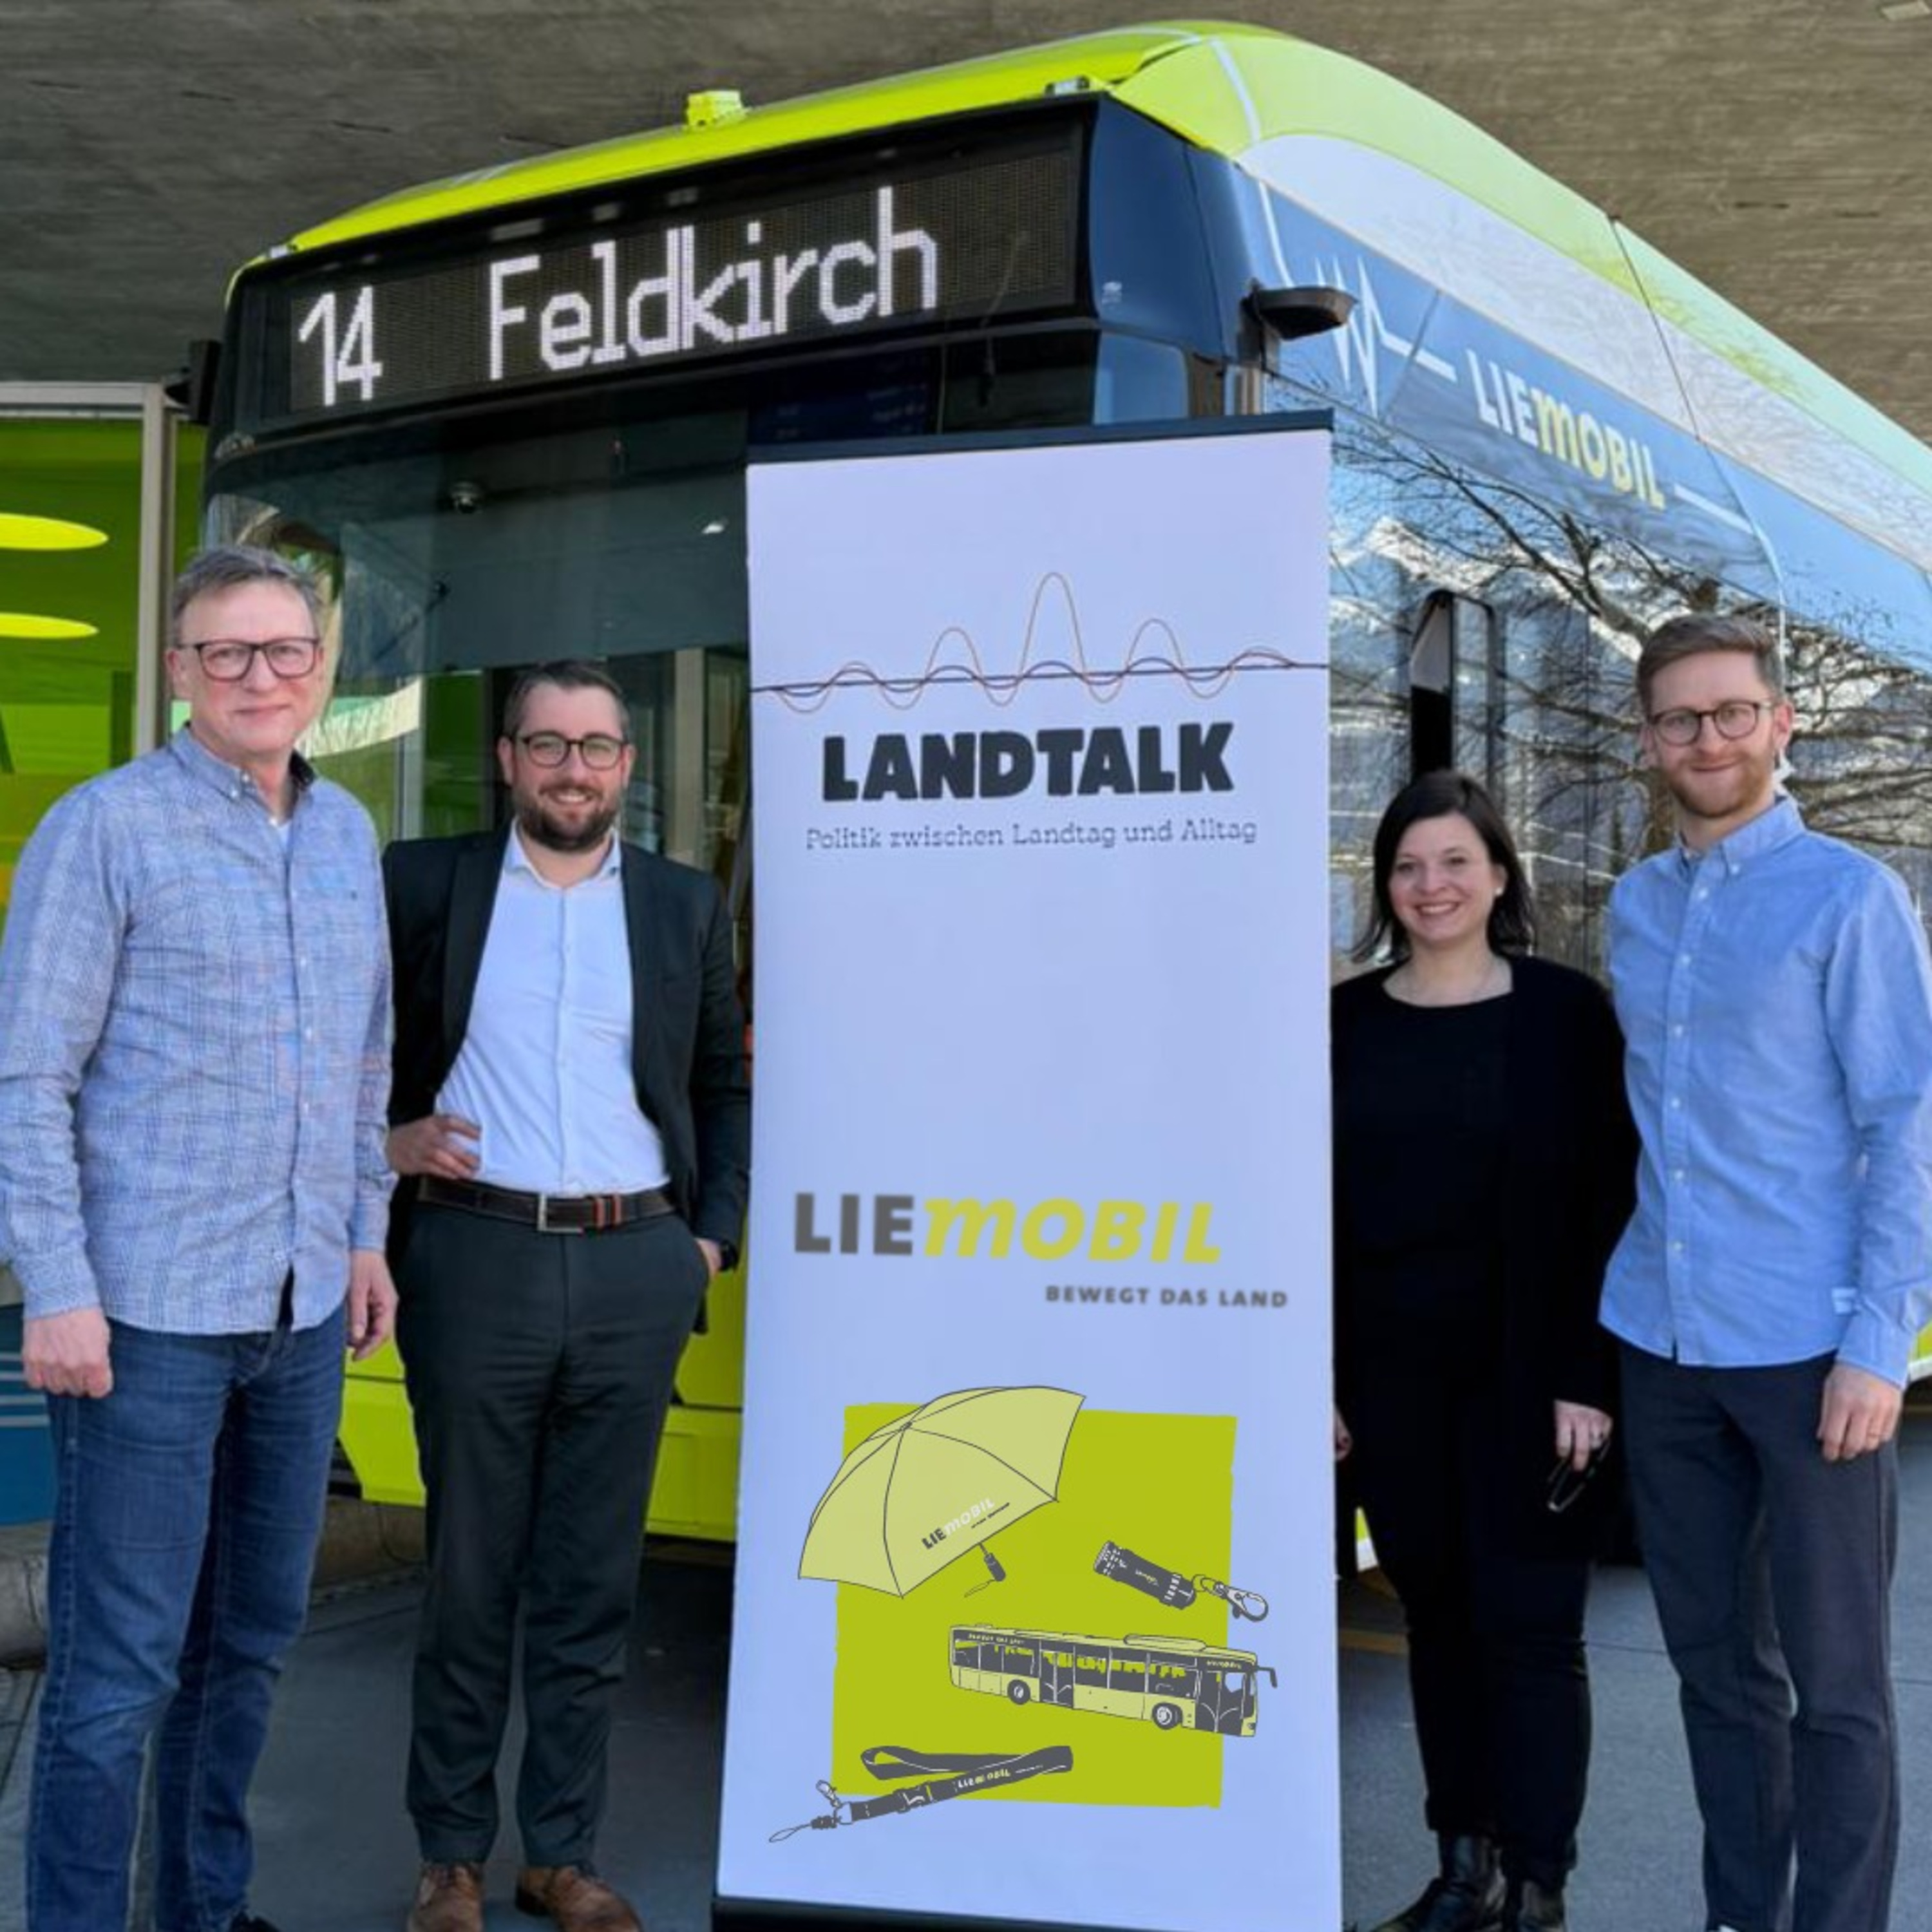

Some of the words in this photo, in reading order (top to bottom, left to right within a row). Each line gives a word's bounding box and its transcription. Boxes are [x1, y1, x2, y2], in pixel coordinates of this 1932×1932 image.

[298, 286, 383, 406] 14
[489, 186, 938, 380] Feldkirch
[822, 722, 1235, 802] LANDTALK
[806, 827, 882, 850] Politik
[889, 823, 1005, 849] zwischen
[1012, 821, 1117, 849] Landtag
[1123, 818, 1174, 843] und
[1180, 817, 1258, 846] Alltag
[1045, 1286, 1151, 1304] BEWEGT
[1160, 1289, 1209, 1307] DAS
[1218, 1290, 1288, 1308] LAND
